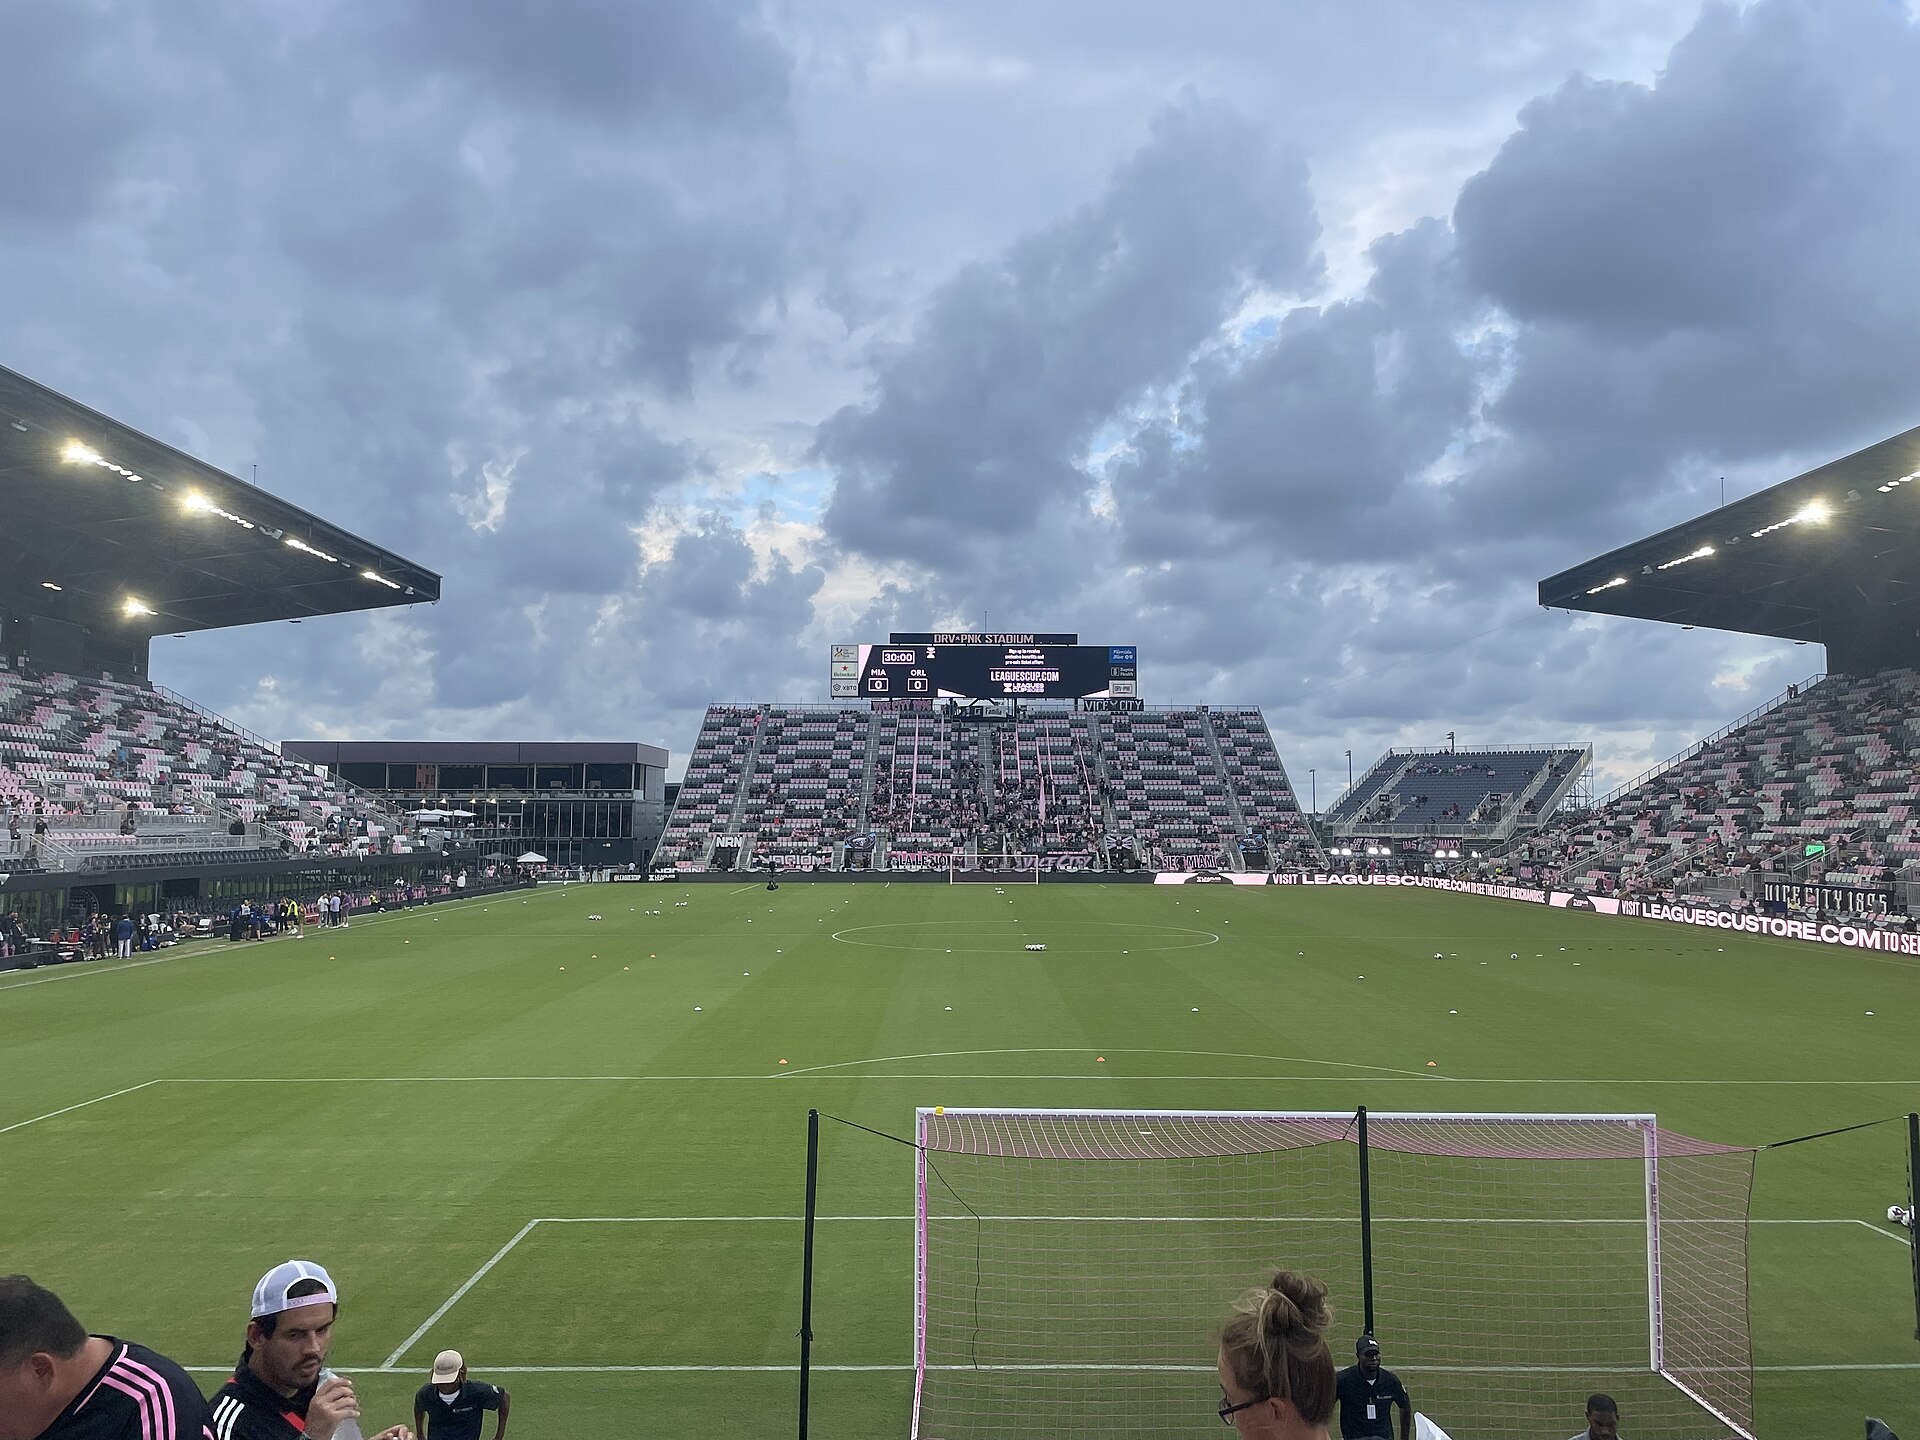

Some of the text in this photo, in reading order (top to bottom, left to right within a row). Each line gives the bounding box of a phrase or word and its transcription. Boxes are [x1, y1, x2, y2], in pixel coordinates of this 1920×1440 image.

[985, 634, 1034, 643] STADIUM
[884, 653, 913, 662] 30:00
[871, 668, 886, 676] MIA
[990, 671, 1060, 682] LEAGUESCUP.COM
[874, 681, 882, 689] 0
[914, 681, 922, 689] 0
[1084, 700, 1142, 711] VICE CITY
[1187, 855, 1218, 869] MIAMI
[1273, 874, 1298, 885] VISIT
[1302, 873, 1471, 893] LEAGUESCUSTORE.COM
[1477, 883, 1486, 895] SEE
[1485, 884, 1494, 896] THE
[1765, 884, 1800, 909] VICE
[1621, 900, 1641, 917] VISIT
[1642, 903, 1881, 950] LEAGUESCUSTORE.COM
[1882, 931, 1899, 952] TO
